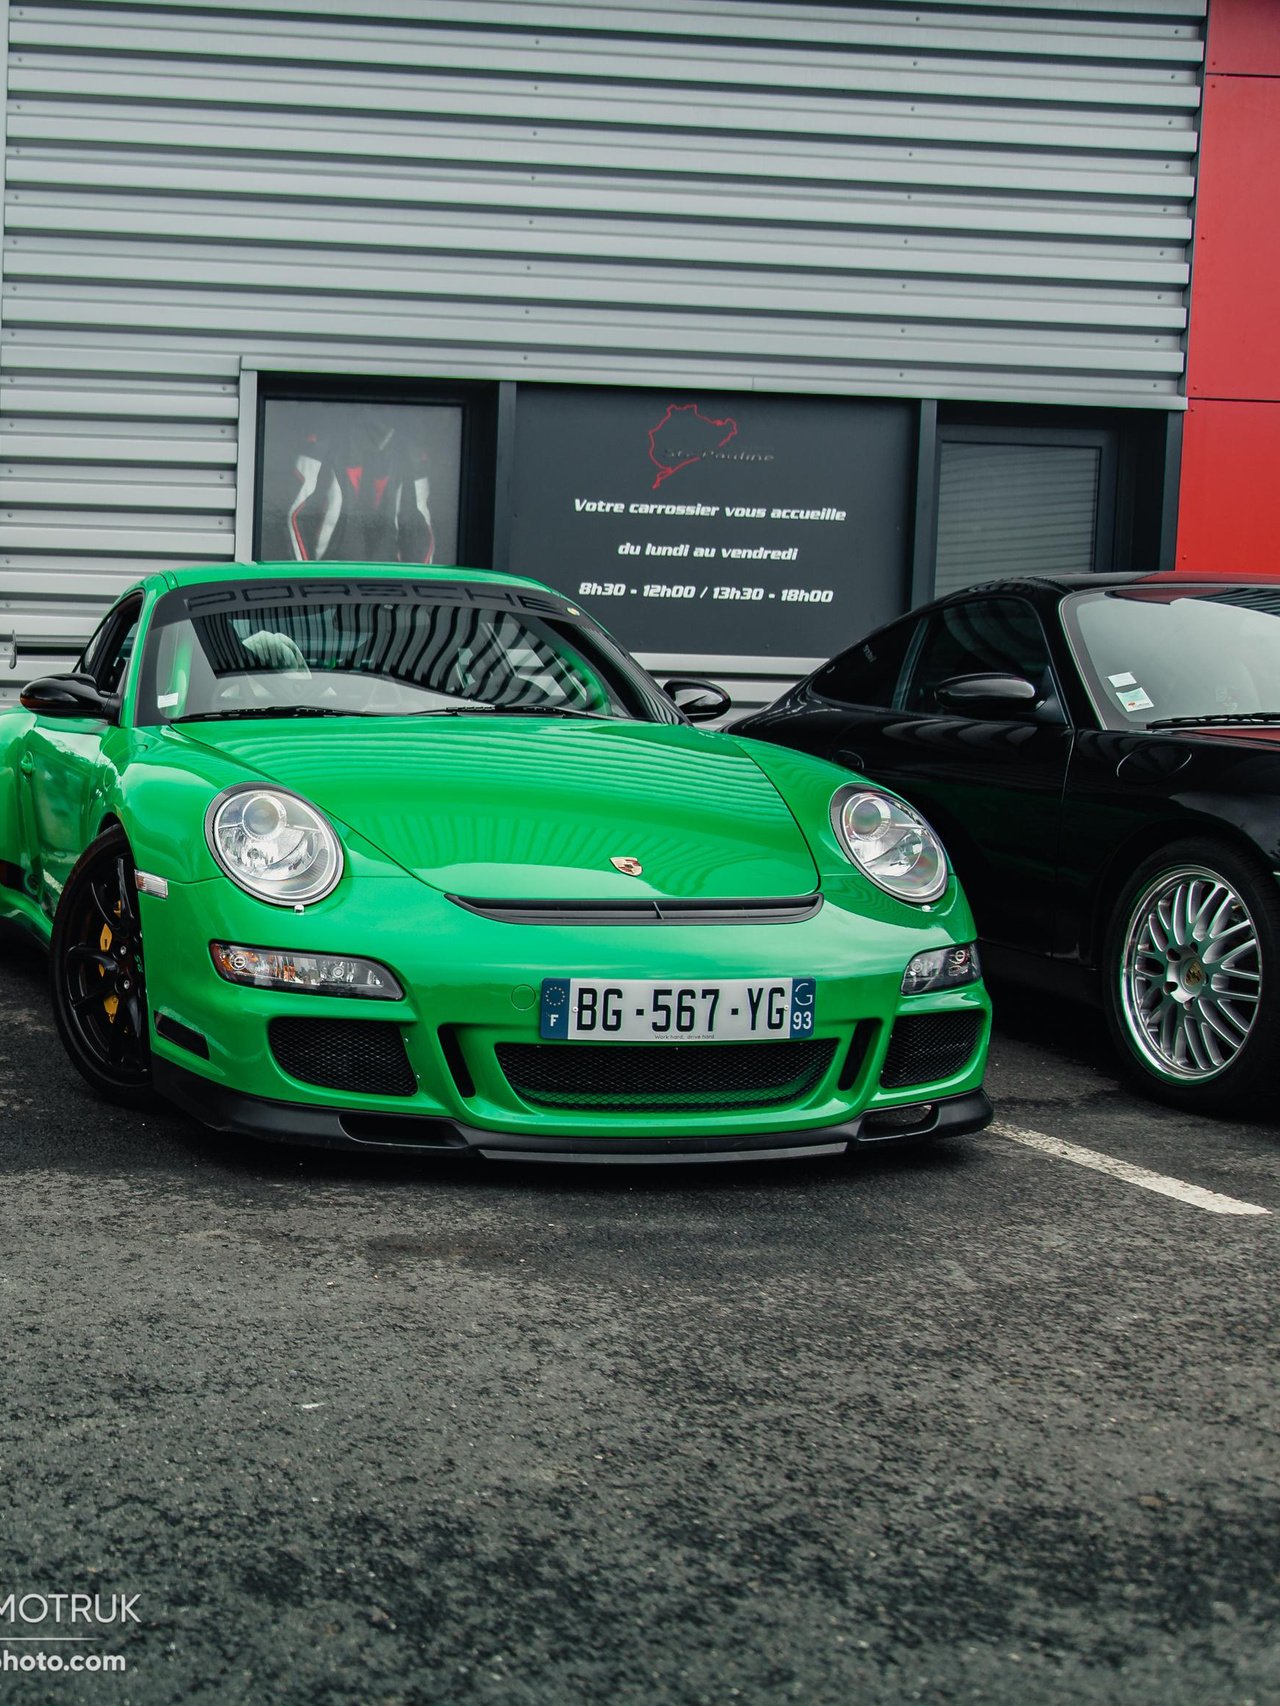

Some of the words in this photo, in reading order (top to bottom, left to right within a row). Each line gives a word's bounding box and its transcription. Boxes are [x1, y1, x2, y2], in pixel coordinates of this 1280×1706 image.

[574, 498, 625, 514] Votre
[628, 502, 720, 517] carrossier
[724, 506, 767, 519] vous
[770, 507, 847, 522] accueille
[617, 541, 642, 556] du
[644, 542, 690, 557] lundi
[692, 546, 717, 558] au
[720, 546, 799, 561] vendredi
[185, 584, 567, 616] PORSCHE
[578, 581, 627, 597] 8h30
[642, 584, 696, 599] 12h00
[699, 585, 709, 599] /
[712, 586, 765, 601] 13h30
[780, 588, 834, 603] 18h00
[549, 1014, 559, 1027] F
[576, 987, 785, 1032] BG-567-YG
[792, 1011, 812, 1030] 93
